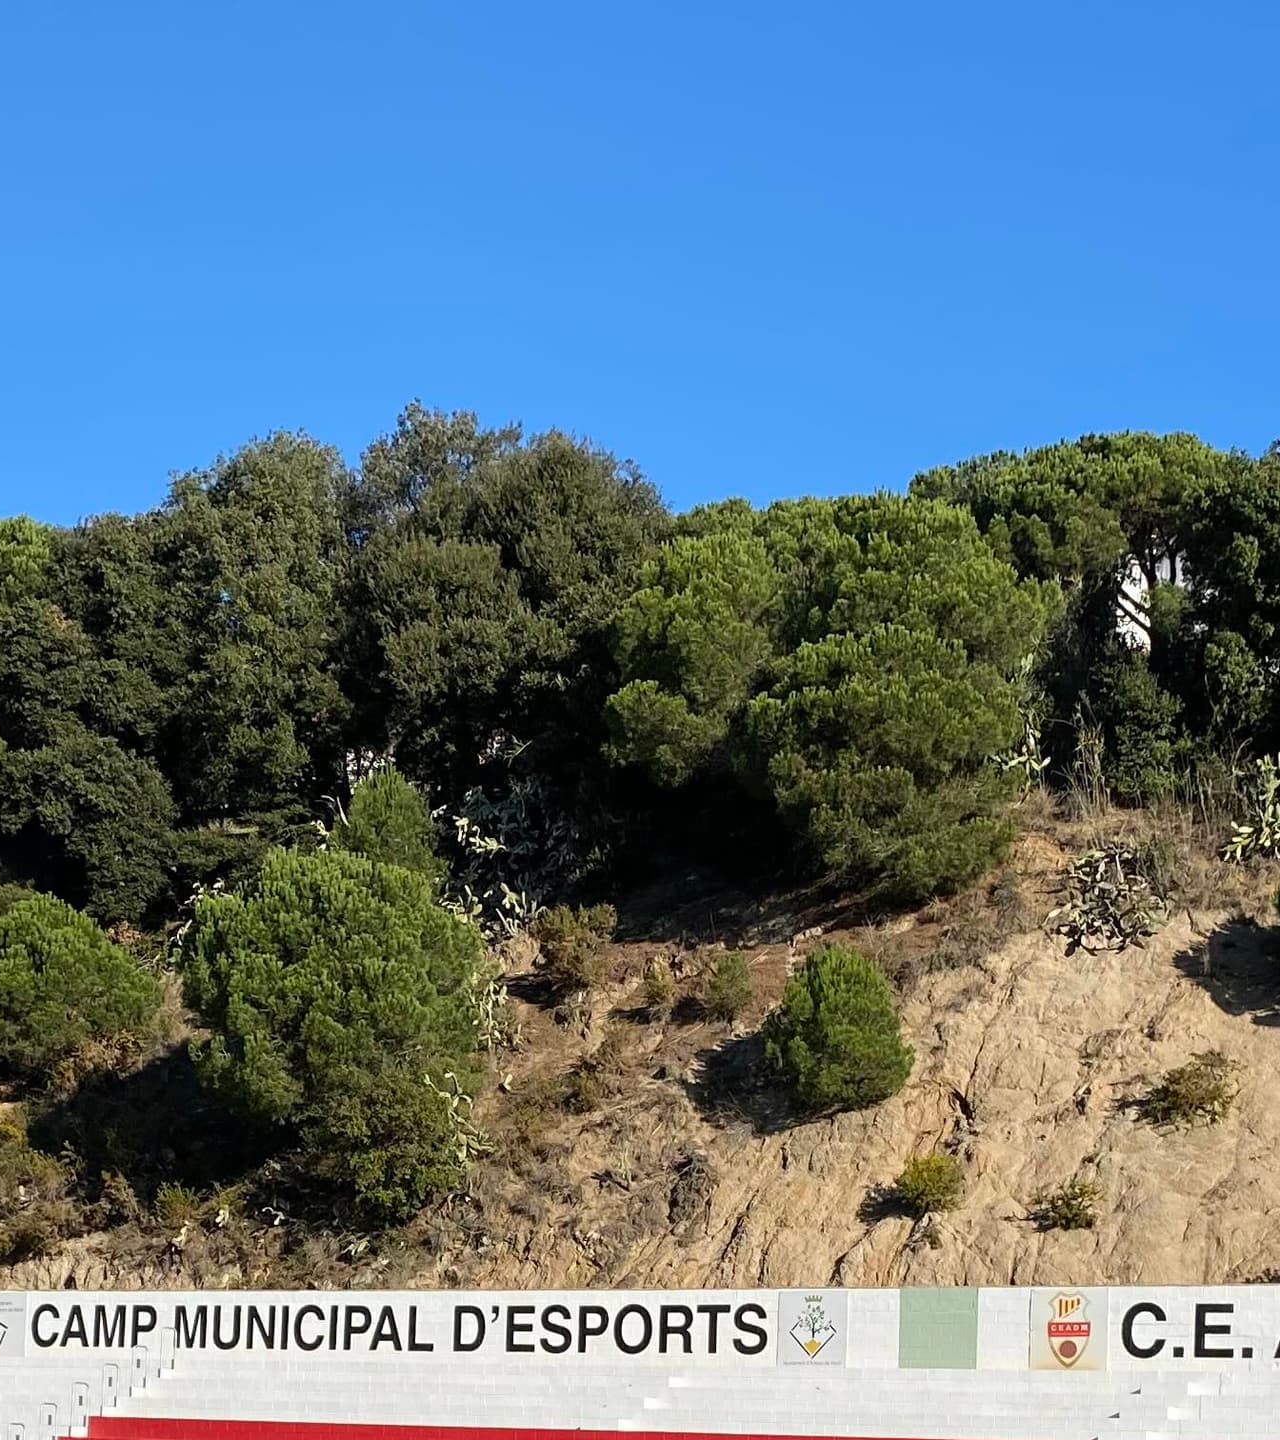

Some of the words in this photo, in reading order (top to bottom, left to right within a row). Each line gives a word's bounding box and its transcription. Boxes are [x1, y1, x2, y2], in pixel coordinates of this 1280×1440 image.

[31, 1303, 157, 1348] CAMP
[174, 1304, 434, 1352] MUNICIPAL
[1050, 1323, 1089, 1332] CEADM
[1121, 1302, 1253, 1359] C.E.
